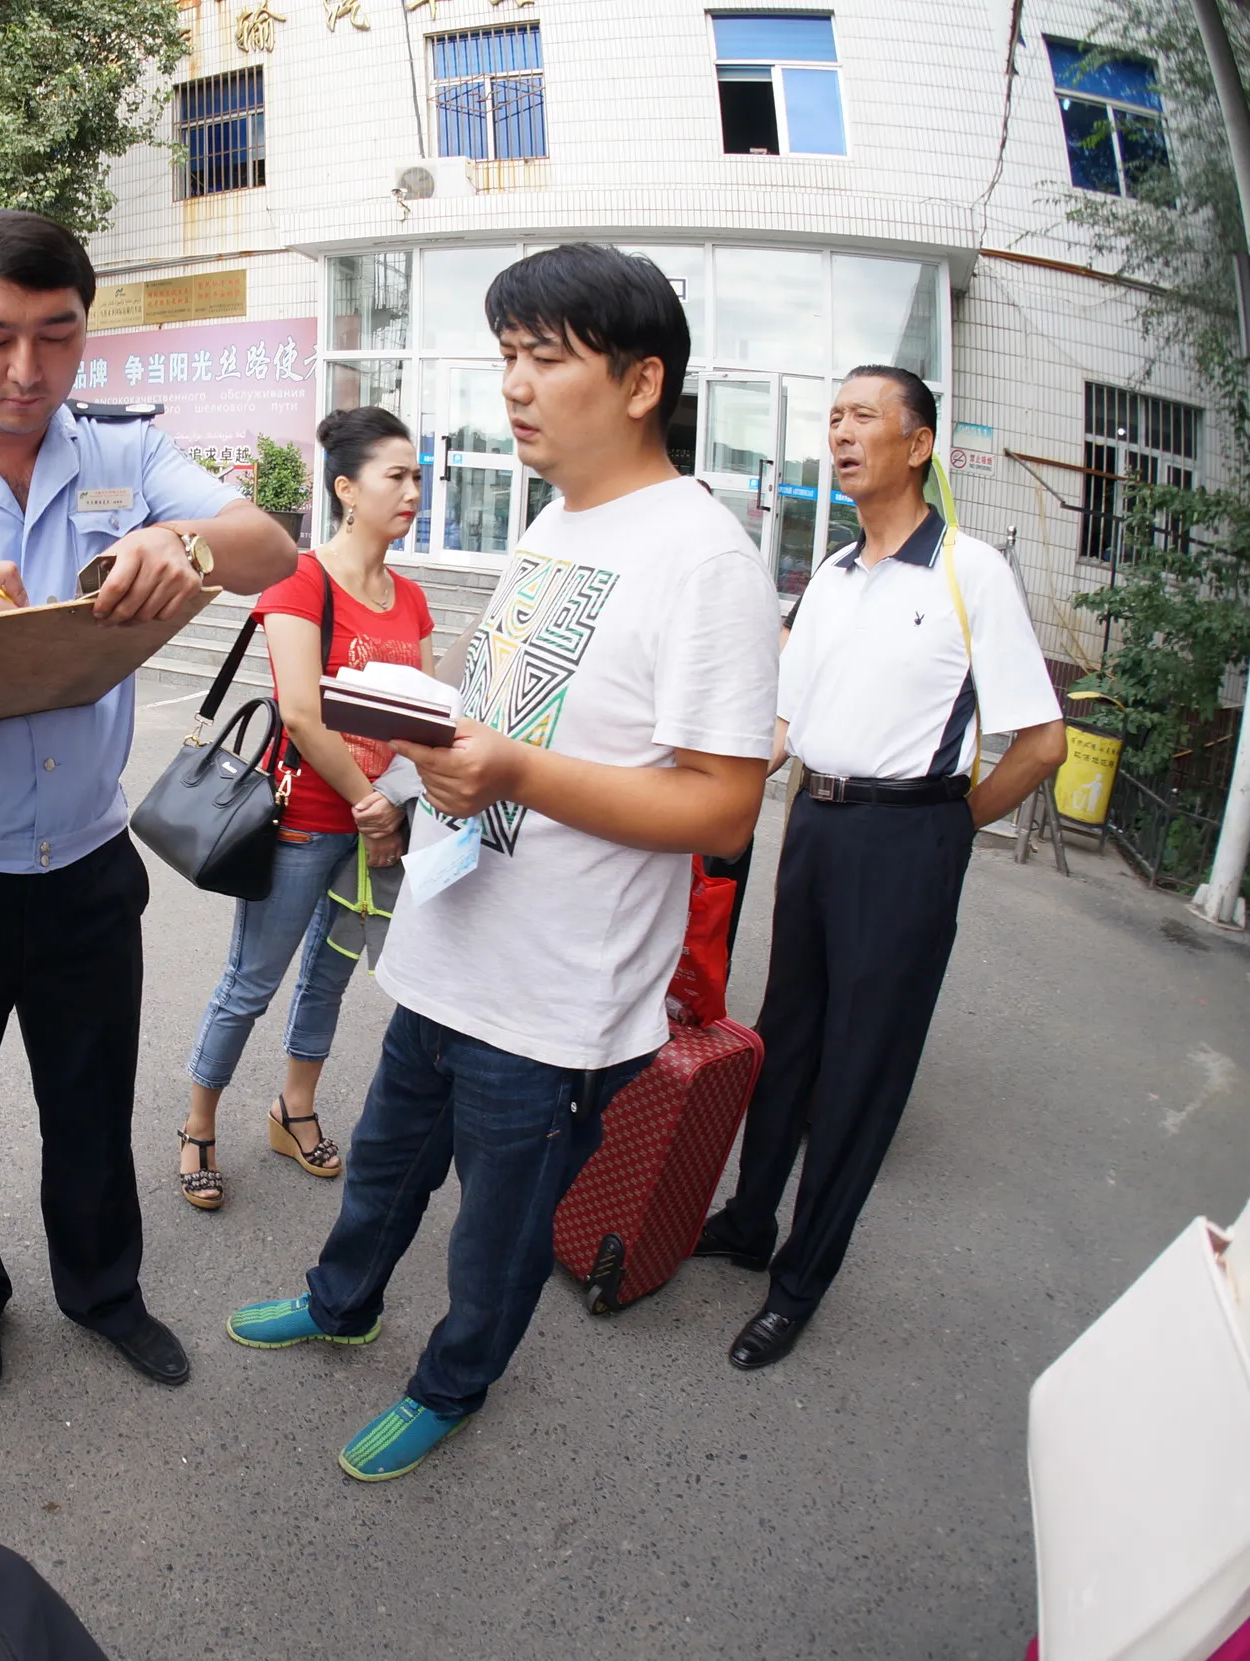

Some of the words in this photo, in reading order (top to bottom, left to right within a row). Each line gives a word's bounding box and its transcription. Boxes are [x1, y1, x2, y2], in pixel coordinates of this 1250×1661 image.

[220, 388, 305, 401] обслуживания
[271, 402, 298, 414] пути
[180, 446, 252, 464] 追求卓越
